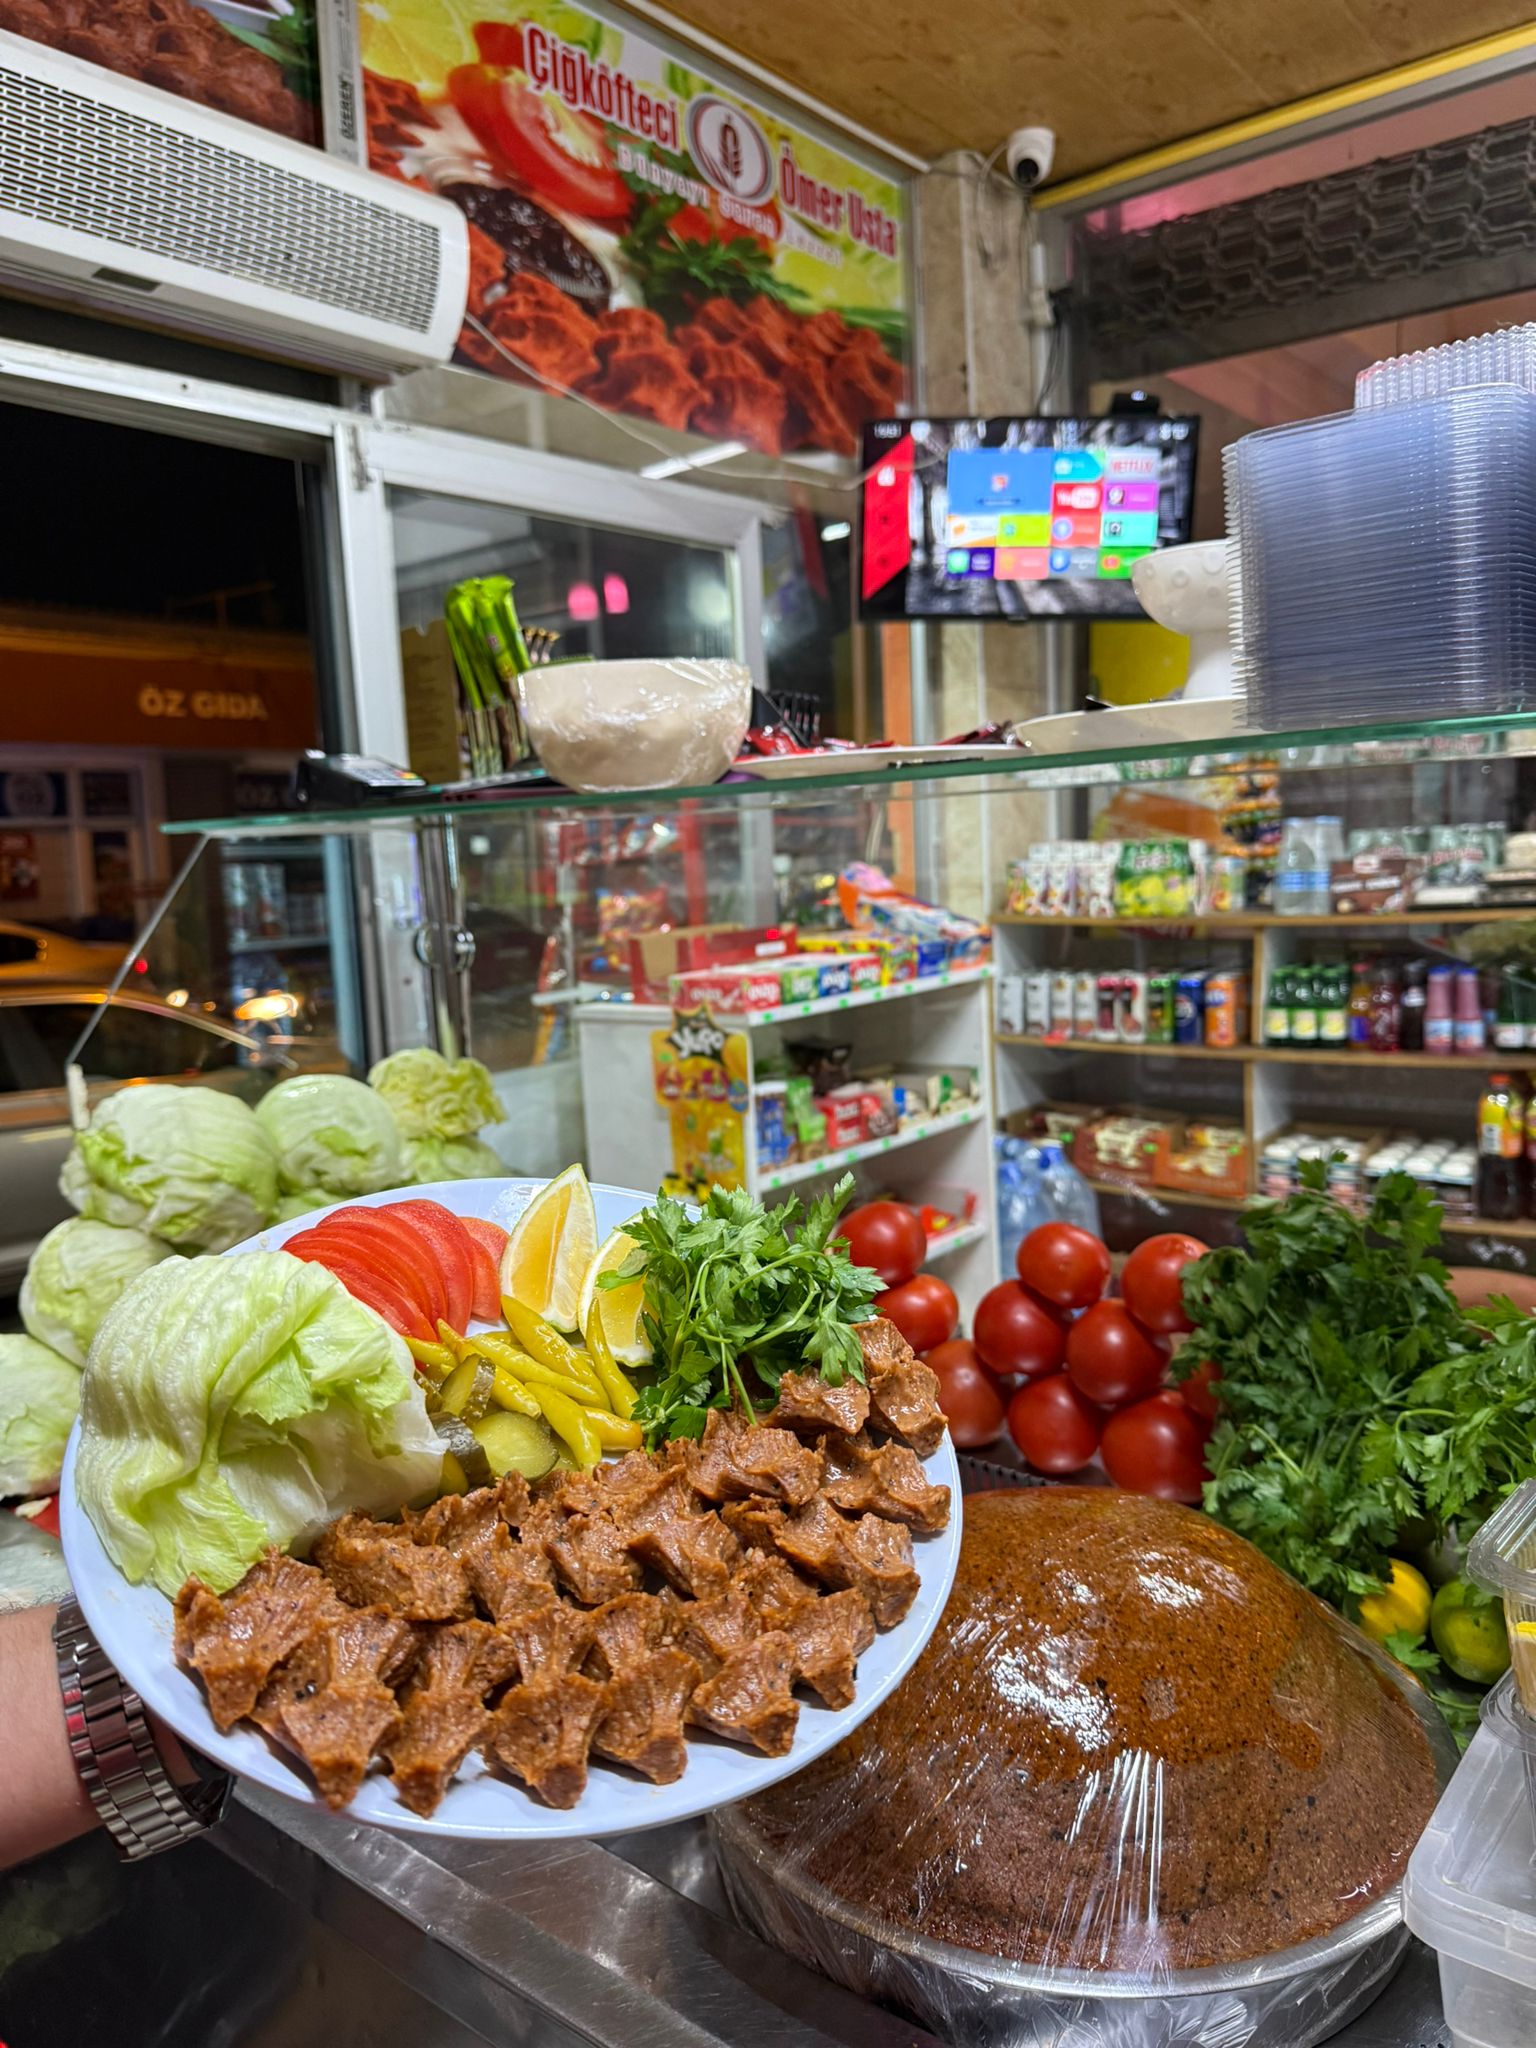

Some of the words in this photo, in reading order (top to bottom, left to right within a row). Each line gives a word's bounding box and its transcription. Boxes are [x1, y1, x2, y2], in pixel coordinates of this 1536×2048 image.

[525, 24, 681, 151] Çiğköfteci
[780, 145, 843, 230] Ömer
[847, 191, 896, 257] Usta
[192, 689, 269, 721] GIDA
